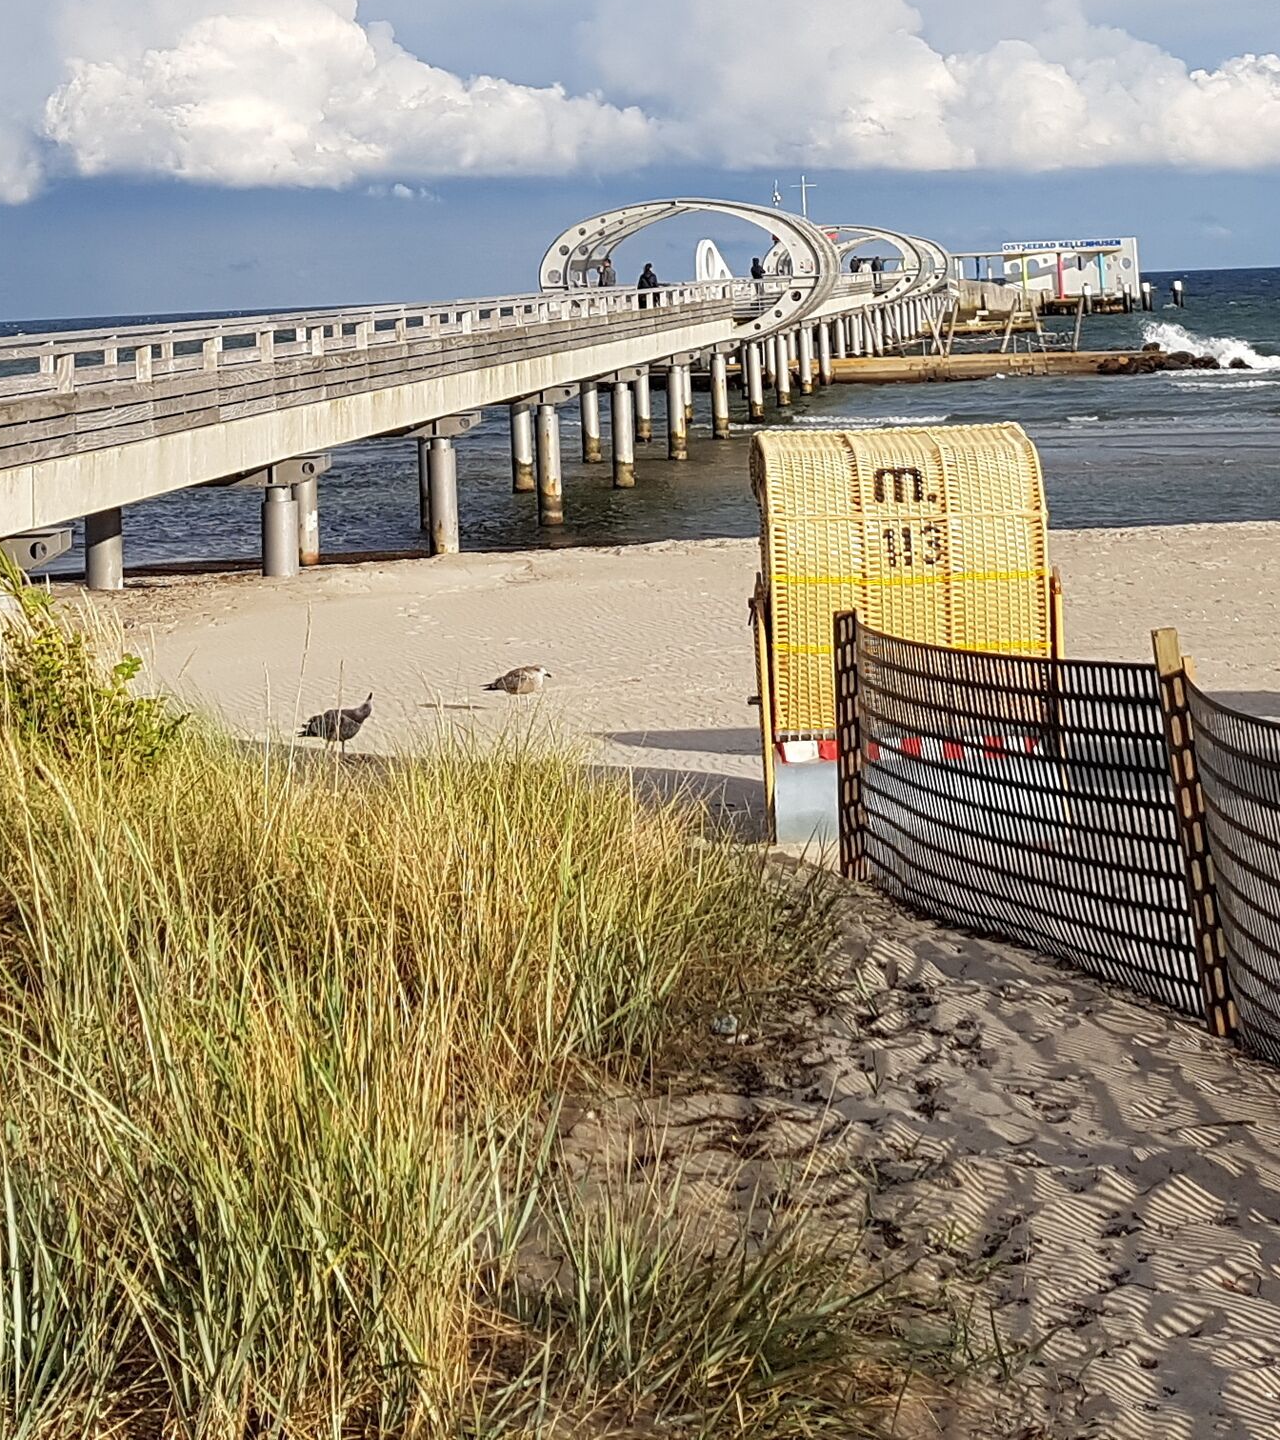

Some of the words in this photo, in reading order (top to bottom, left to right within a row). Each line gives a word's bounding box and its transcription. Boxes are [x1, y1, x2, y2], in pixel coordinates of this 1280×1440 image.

[1003, 242, 1056, 252] OSTSEEBAD
[1059, 239, 1121, 249] KELLENHUSEN
[882, 525, 941, 568] 113
